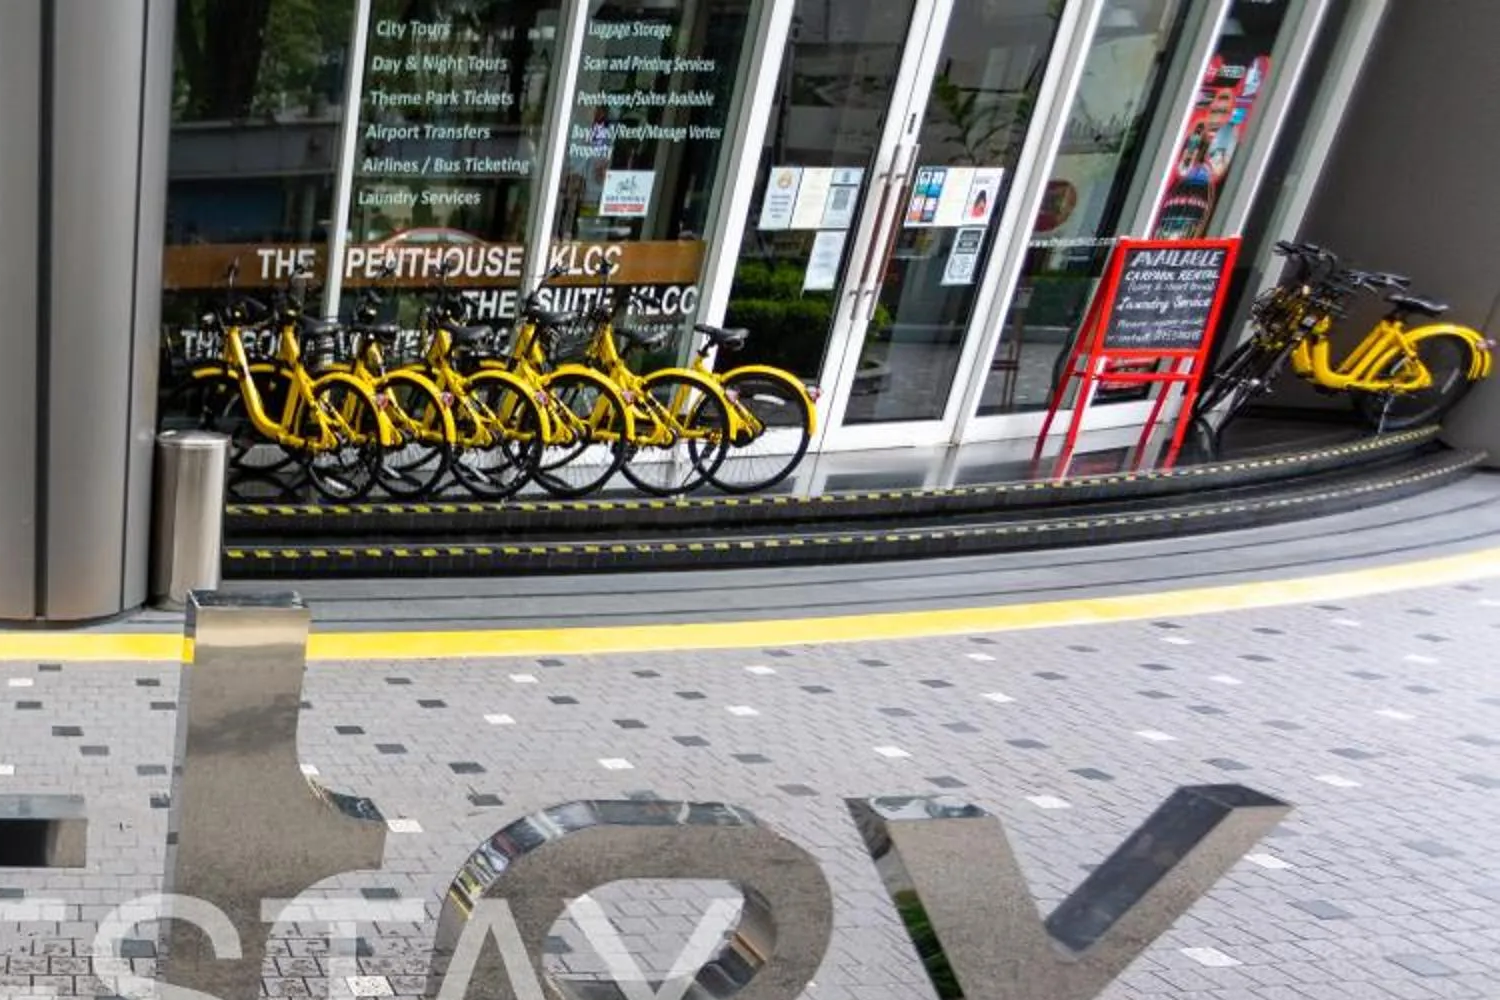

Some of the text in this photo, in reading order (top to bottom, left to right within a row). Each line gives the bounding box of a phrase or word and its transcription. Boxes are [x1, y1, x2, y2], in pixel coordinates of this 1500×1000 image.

[377, 20, 451, 37] City Tours
[589, 21, 672, 39] Luggage Storage
[372, 55, 508, 74] Day & Night Tours
[584, 56, 715, 74] Scan and Printing Services
[370, 89, 513, 106] Theme Park Tickets
[578, 91, 715, 108] Penthouse/Suites Available
[365, 124, 491, 142] Airport Transfers
[689, 124, 723, 139] Vortex
[569, 143, 612, 160] Property
[362, 156, 530, 174] Airlines / Bus Ticketing
[358, 190, 482, 208] Laundry Services
[257, 245, 623, 279] THE PENTHOUSE KLCC
[1131, 249, 1224, 267] AVAILABLE
[462, 289, 518, 319] THE
[537, 286, 613, 314] SUITE
